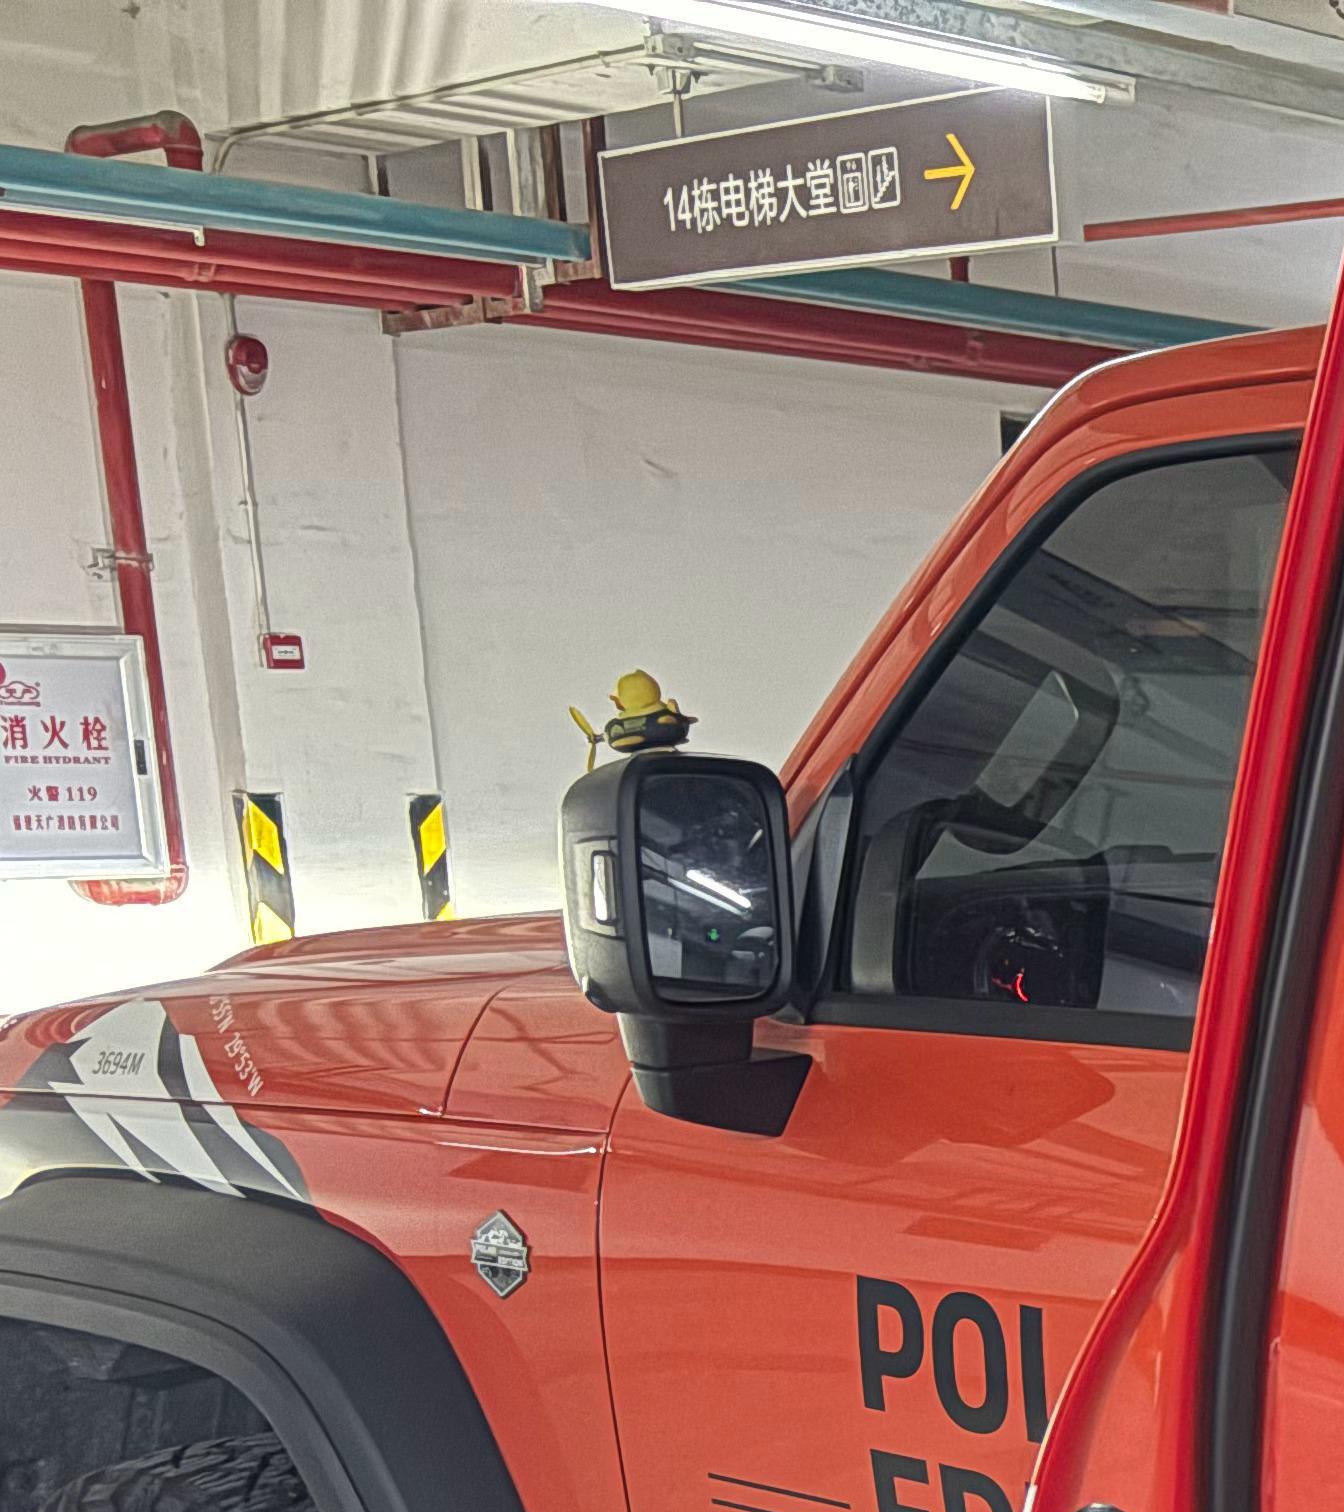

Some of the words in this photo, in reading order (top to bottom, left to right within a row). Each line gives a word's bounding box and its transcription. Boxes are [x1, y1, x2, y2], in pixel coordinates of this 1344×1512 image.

[663, 158, 838, 233] 14栋电梯大堂
[1, 714, 109, 751] 消火栓
[4, 755, 40, 765] FIRE
[43, 755, 112, 765] HYDRANT
[66, 786, 98, 802] 119
[91, 1050, 146, 1076] 3694M
